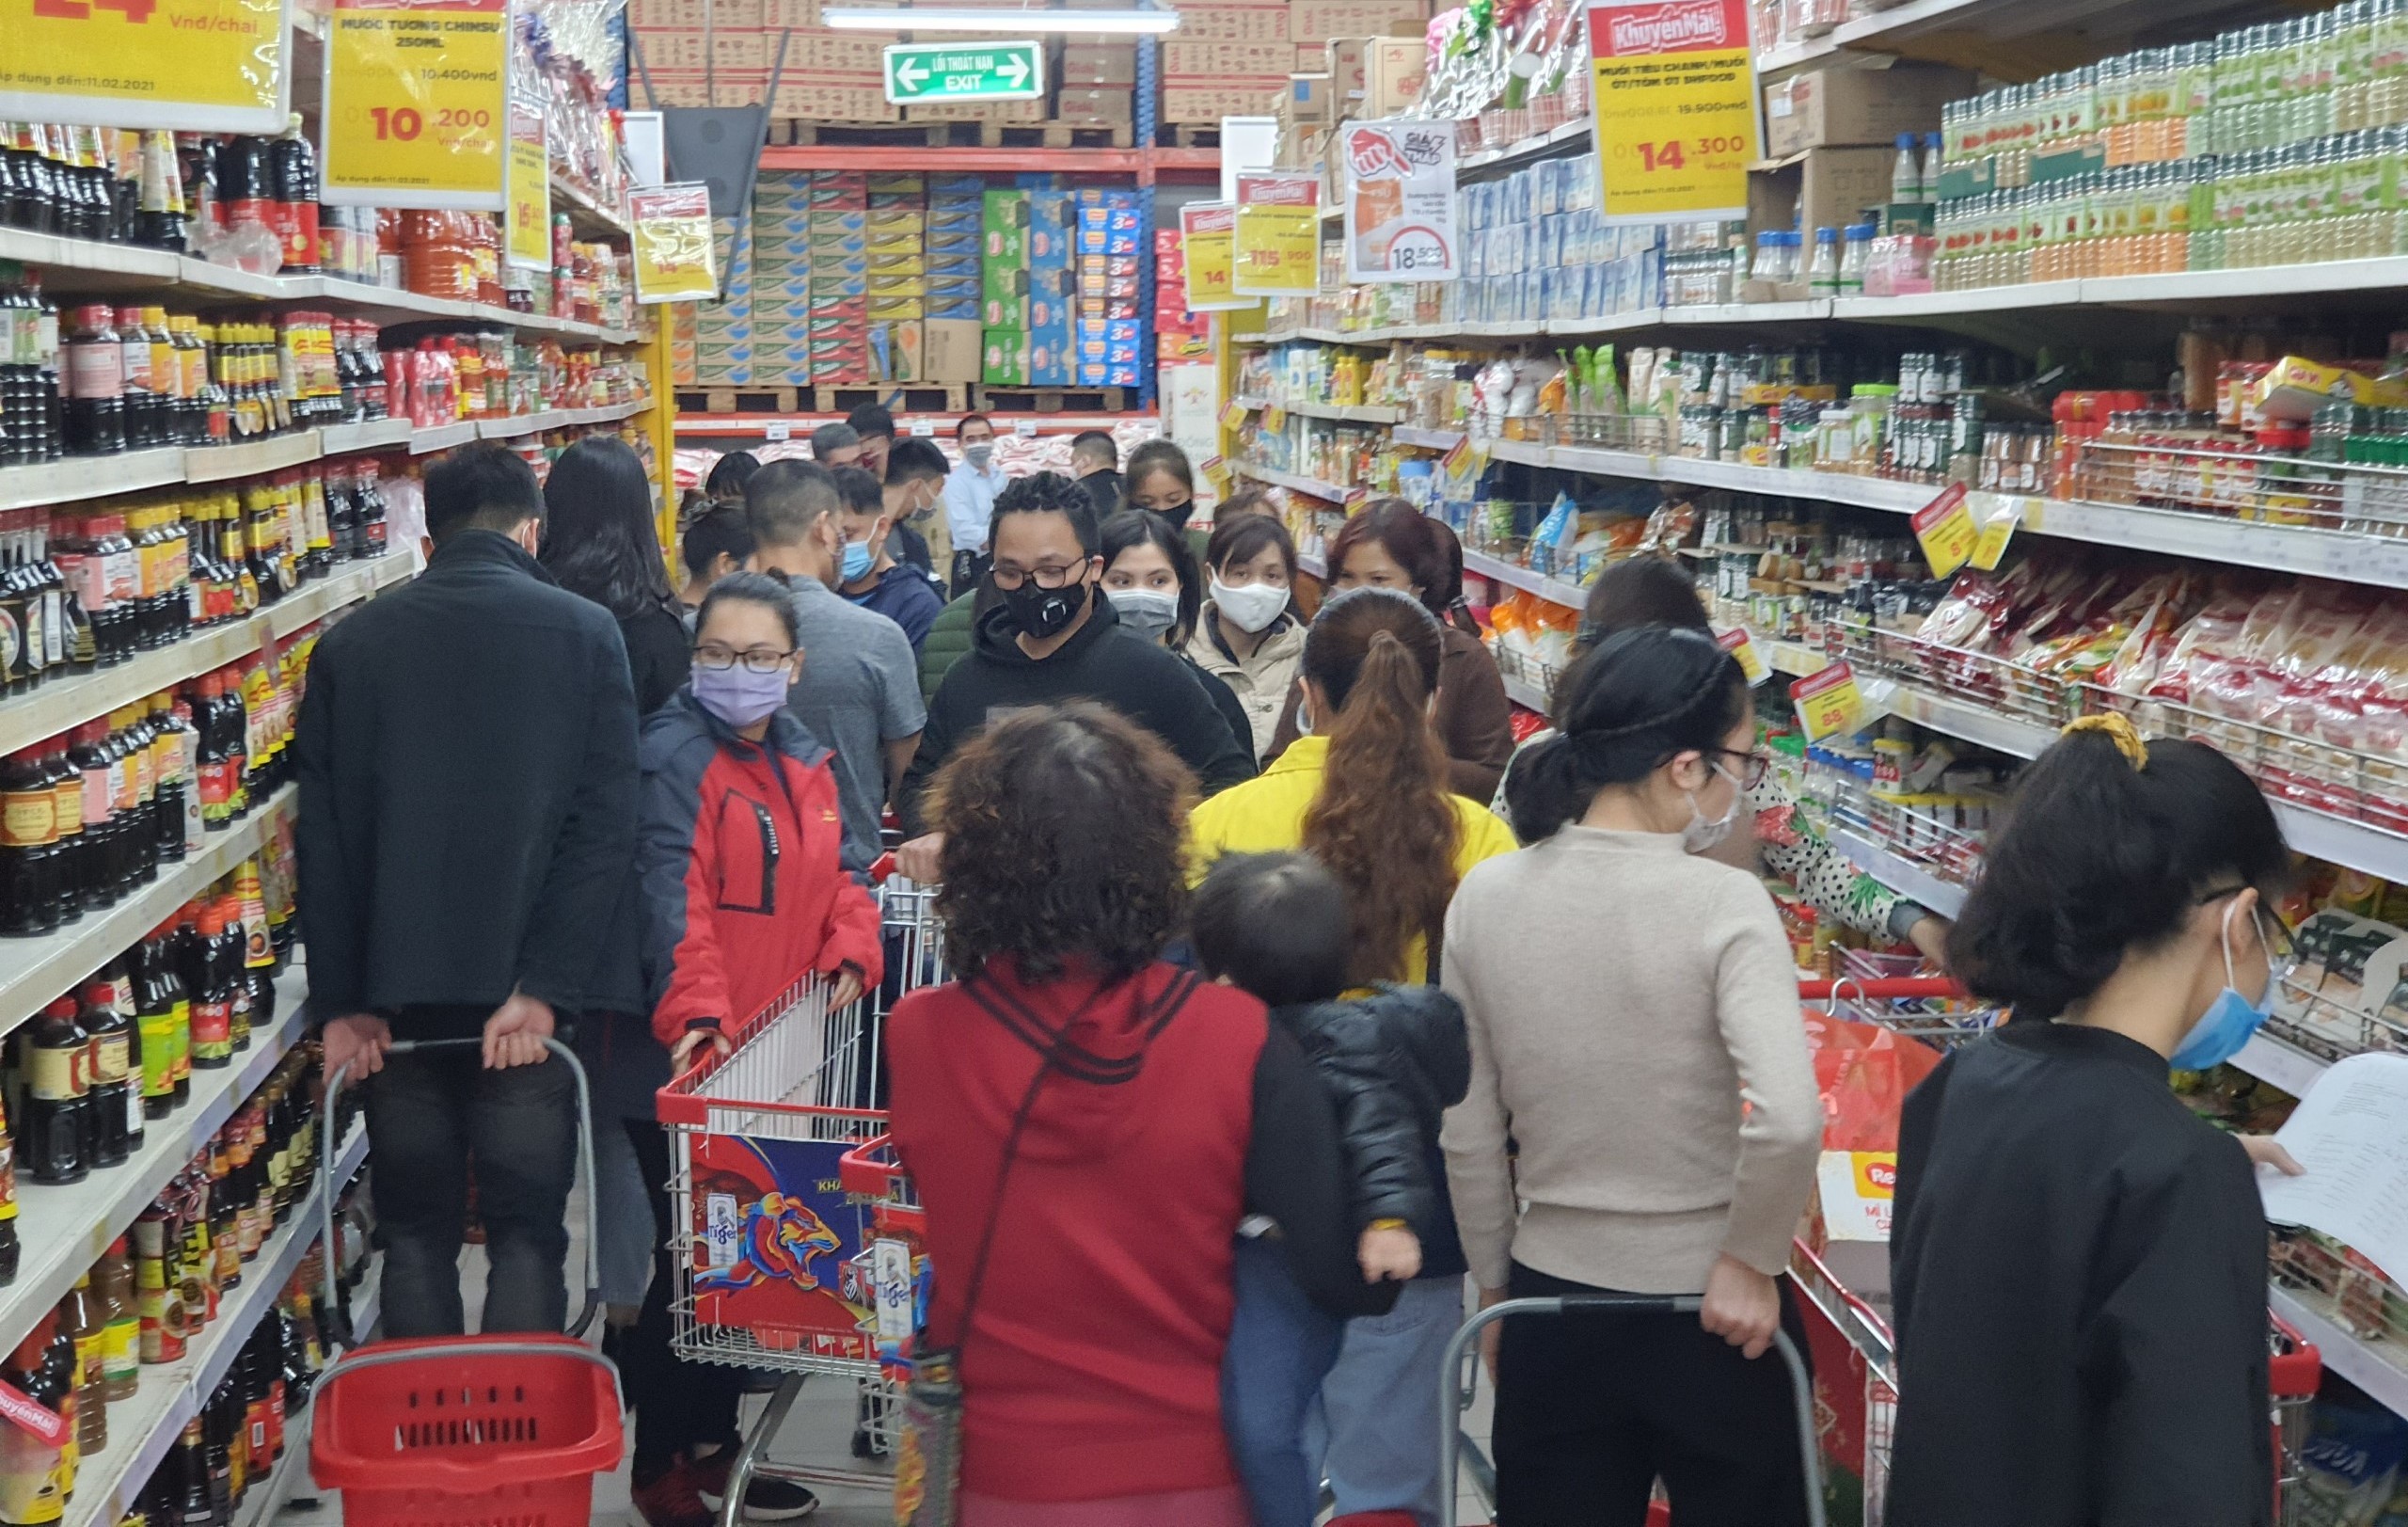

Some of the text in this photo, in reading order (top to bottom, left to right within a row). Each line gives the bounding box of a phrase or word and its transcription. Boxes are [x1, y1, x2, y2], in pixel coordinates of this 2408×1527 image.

[169, 13, 259, 34] Vnđ/chai
[944, 73, 983, 91] EXIT
[371, 107, 423, 141] 10
[1638, 140, 1686, 172] 14
[1393, 247, 1416, 270] 18
[1204, 270, 1226, 284] 14
[708, 1224, 737, 1246] Tiger
